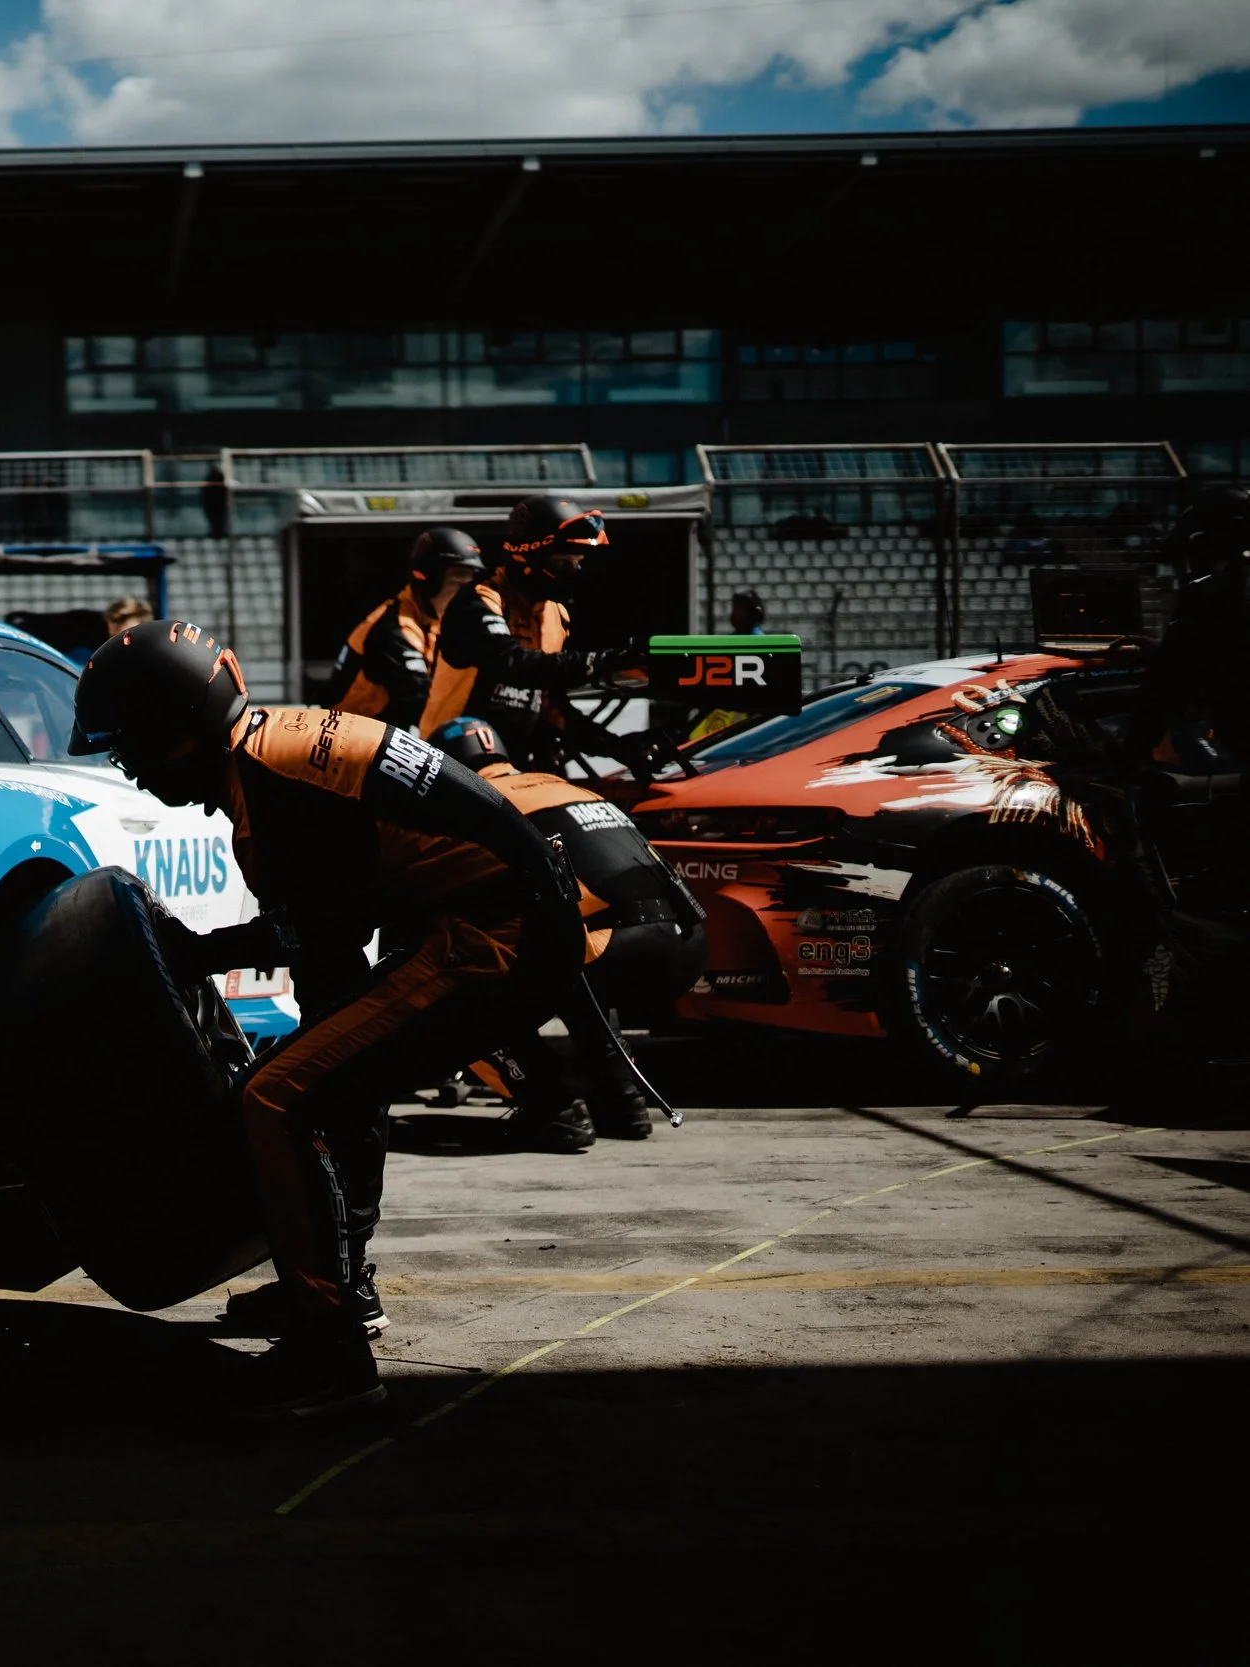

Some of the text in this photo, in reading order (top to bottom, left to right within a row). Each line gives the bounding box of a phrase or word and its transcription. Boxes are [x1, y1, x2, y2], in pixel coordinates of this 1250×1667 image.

[678, 655, 767, 686] J2R
[134, 836, 227, 897] KNAUS
[675, 861, 738, 880] ACING
[798, 935, 871, 967] eng3
